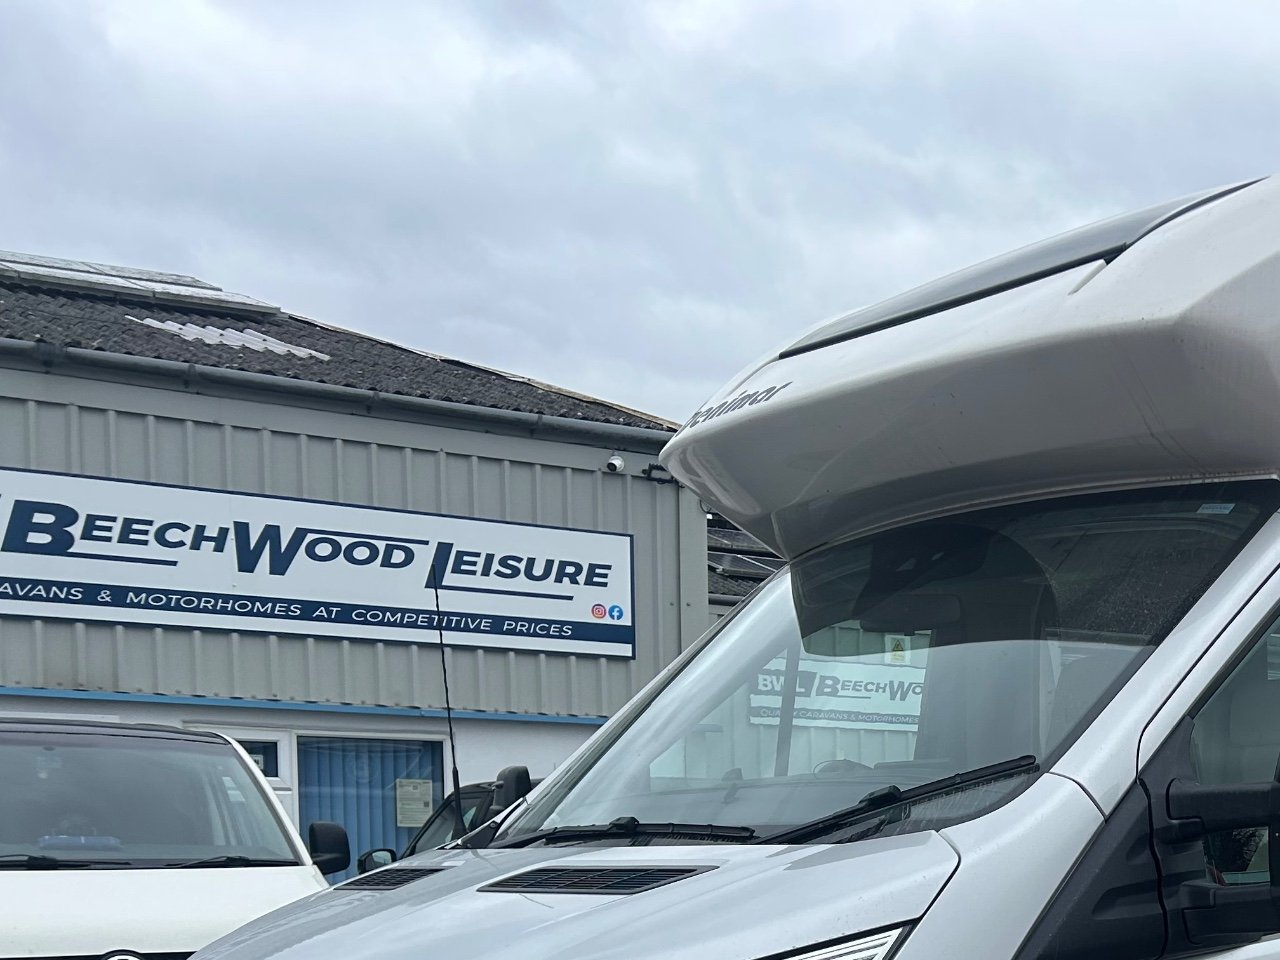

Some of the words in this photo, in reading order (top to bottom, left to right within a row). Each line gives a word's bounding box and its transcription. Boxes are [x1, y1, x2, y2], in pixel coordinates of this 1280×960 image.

[424, 541, 613, 589] LEISURE
[97, 589, 112, 602] &
[126, 591, 302, 616] MOTORHOMES
[312, 606, 341, 619] AT
[351, 609, 493, 631] COMPETITIVE
[502, 621, 574, 636] PRICES
[800, 711, 849, 721] CARAVANS
[858, 714, 919, 724] MOTORHOMES
